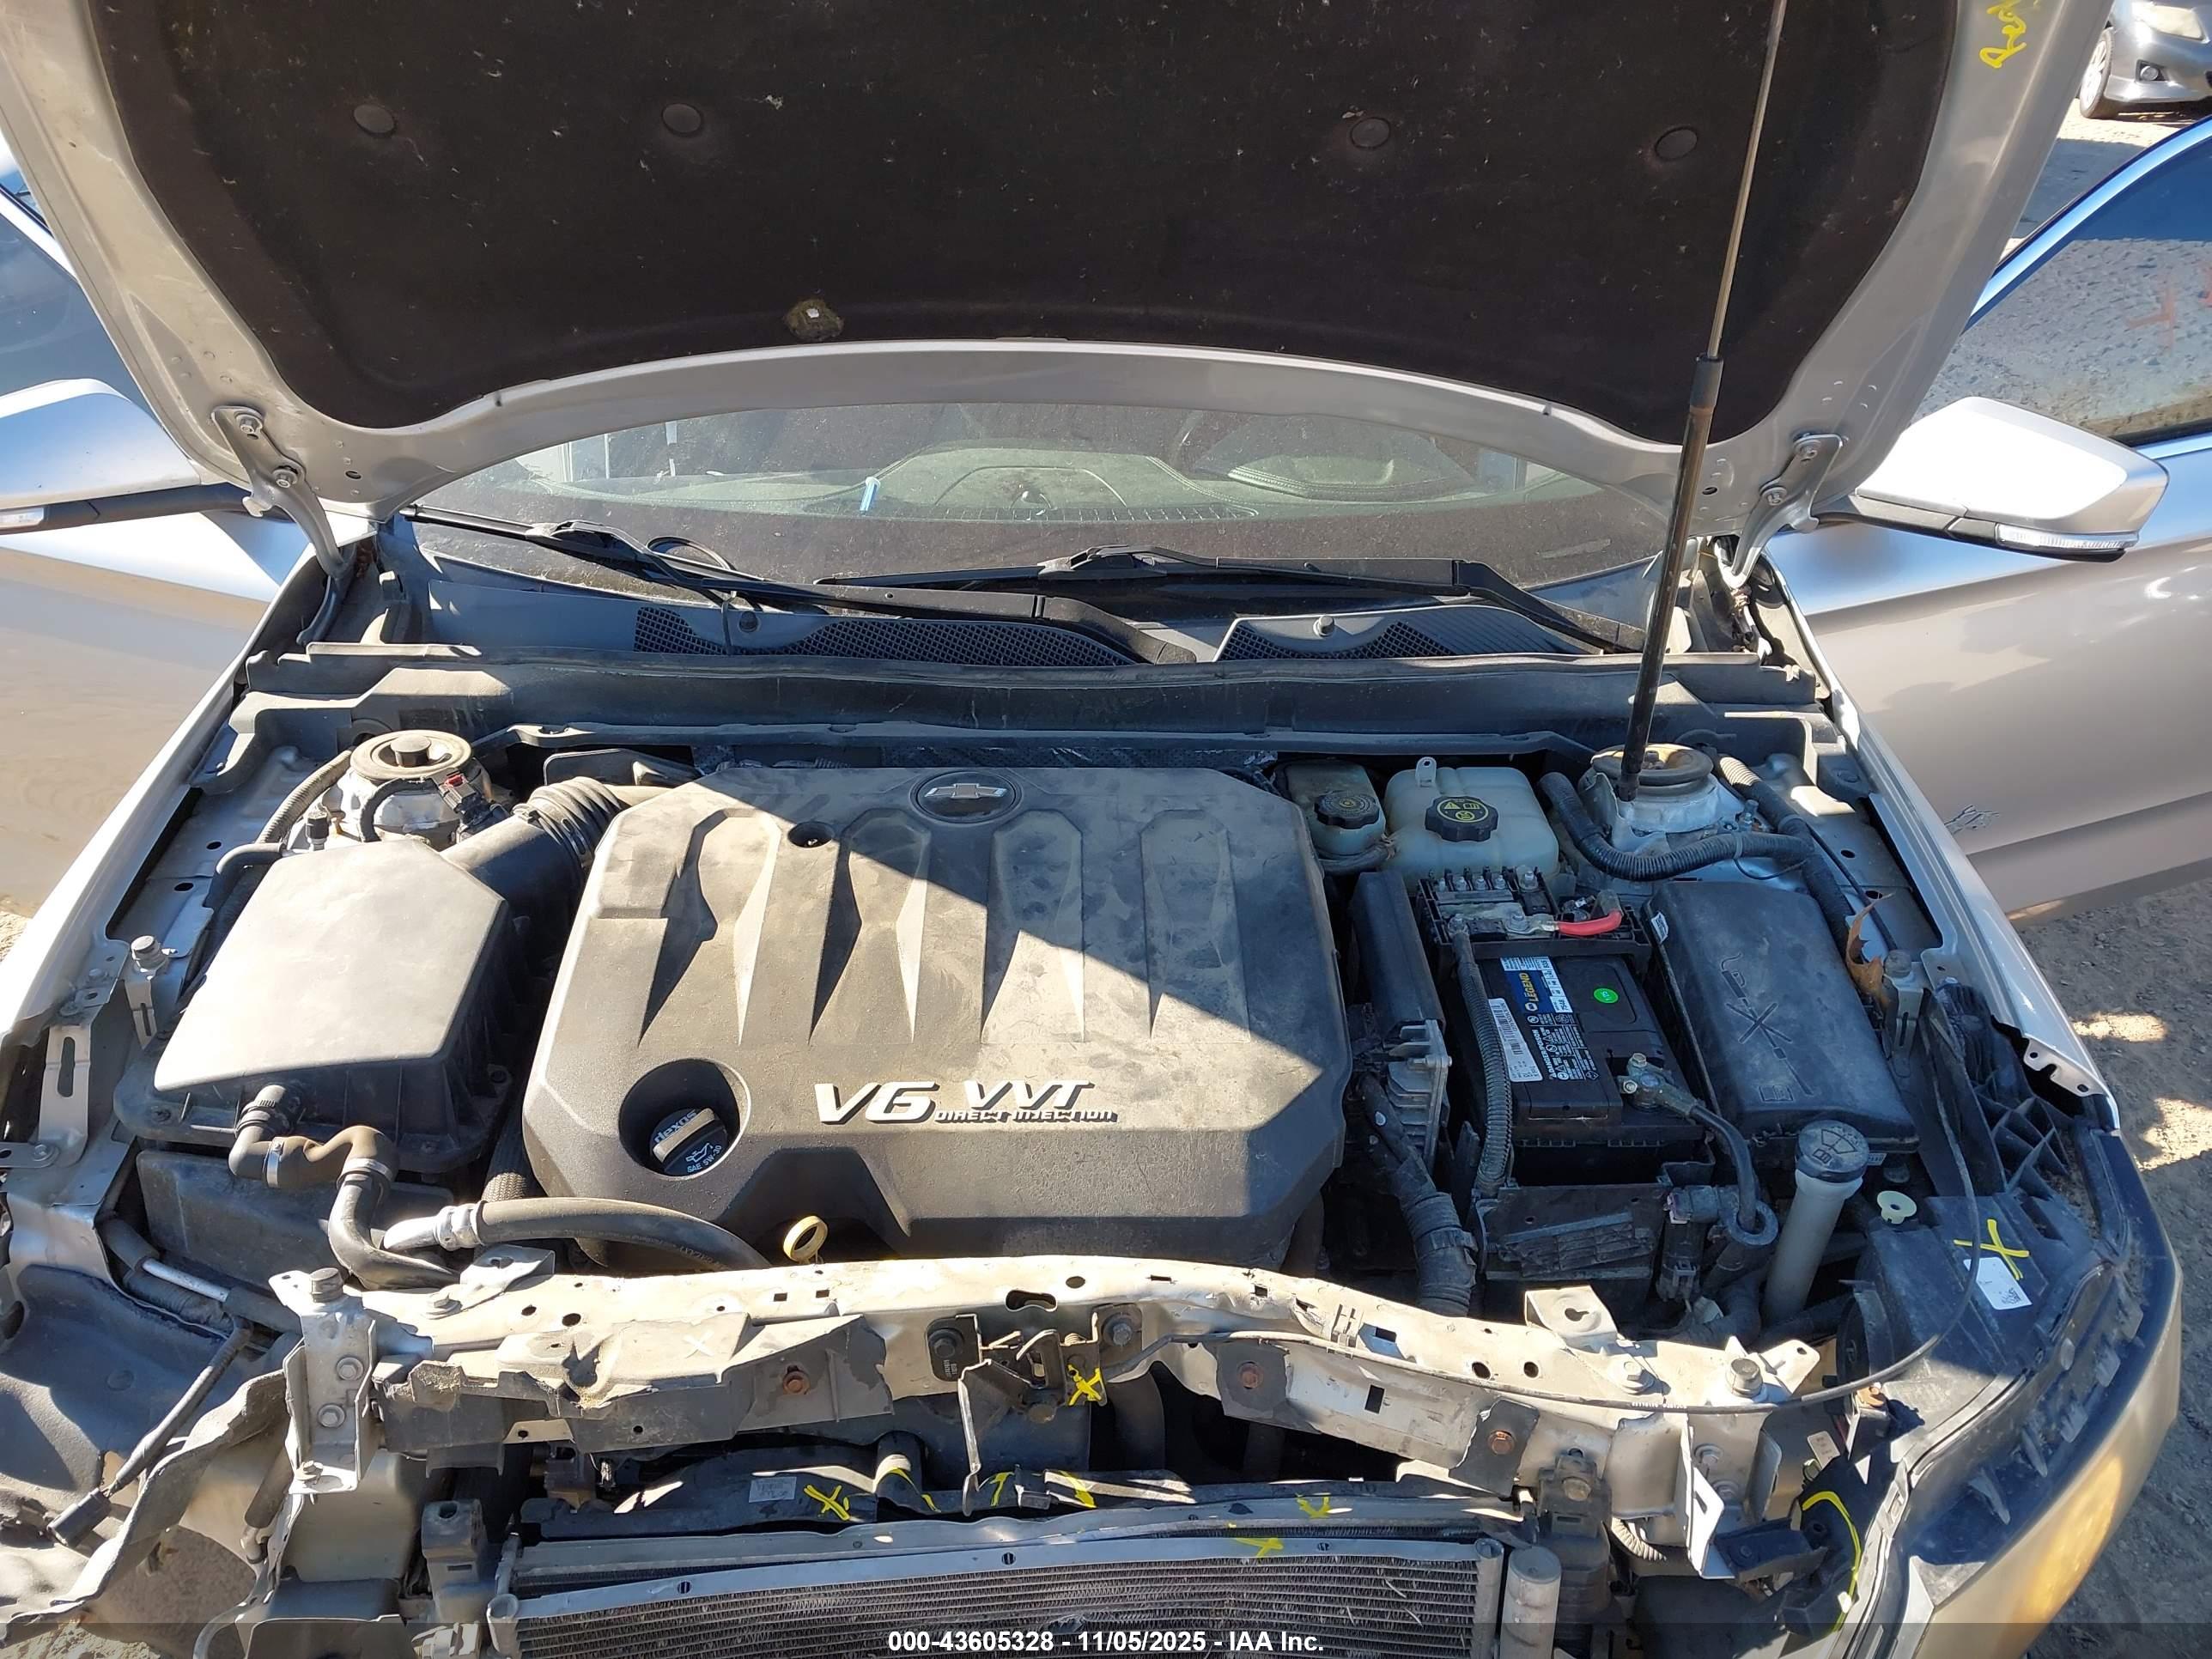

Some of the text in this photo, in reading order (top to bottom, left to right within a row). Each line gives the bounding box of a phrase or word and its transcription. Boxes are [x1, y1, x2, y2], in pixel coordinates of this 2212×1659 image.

[1519, 972, 1539, 1002] LEGEND
[1532, 1029, 1555, 1073] DANGER/POISON
[814, 1080, 1096, 1125] V6 VVT
[935, 1109, 1118, 1123] DIRECT INJECTION
[654, 1109, 696, 1143] dexos
[687, 1145, 722, 1173] SAE 5W-30
